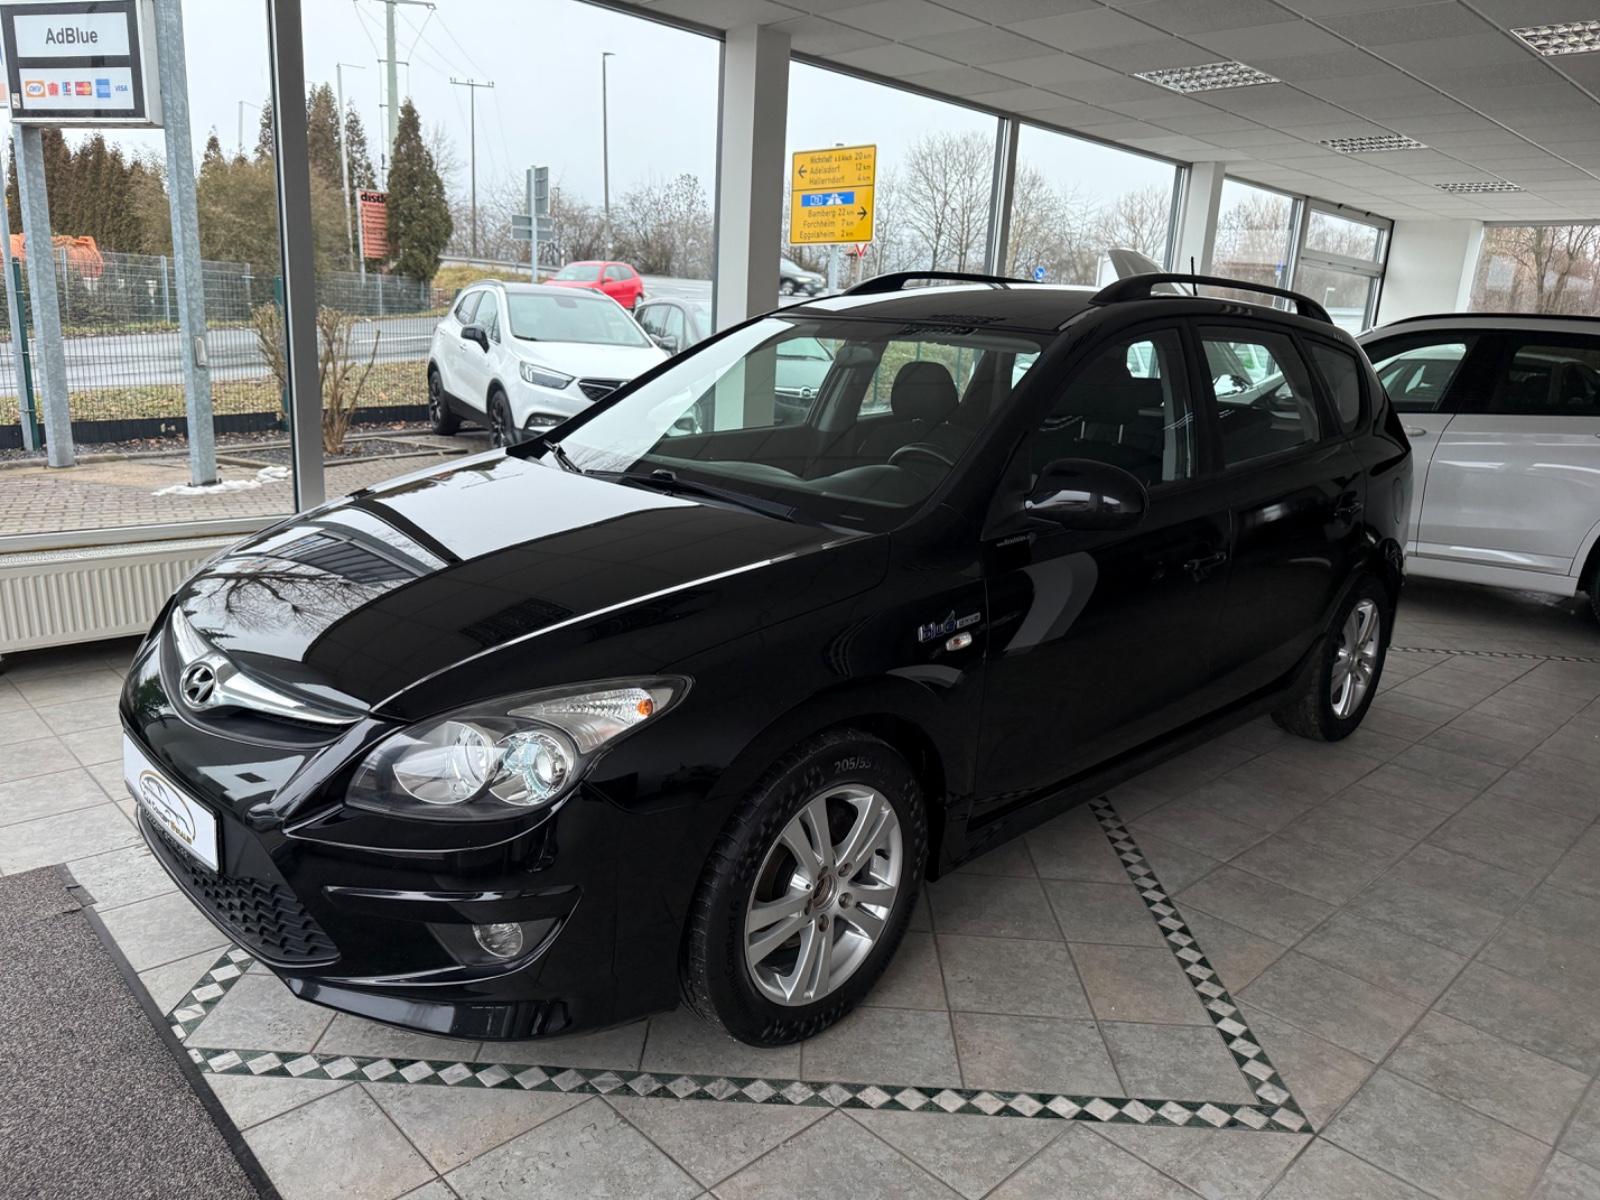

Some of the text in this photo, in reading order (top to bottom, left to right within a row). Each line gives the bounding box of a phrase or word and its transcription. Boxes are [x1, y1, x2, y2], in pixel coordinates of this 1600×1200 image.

[45, 27, 98, 44] AdBlue
[854, 152, 863, 161] 20
[855, 163, 862, 171] 12
[808, 209, 836, 218] Bamberg
[803, 219, 835, 229] Forchheim
